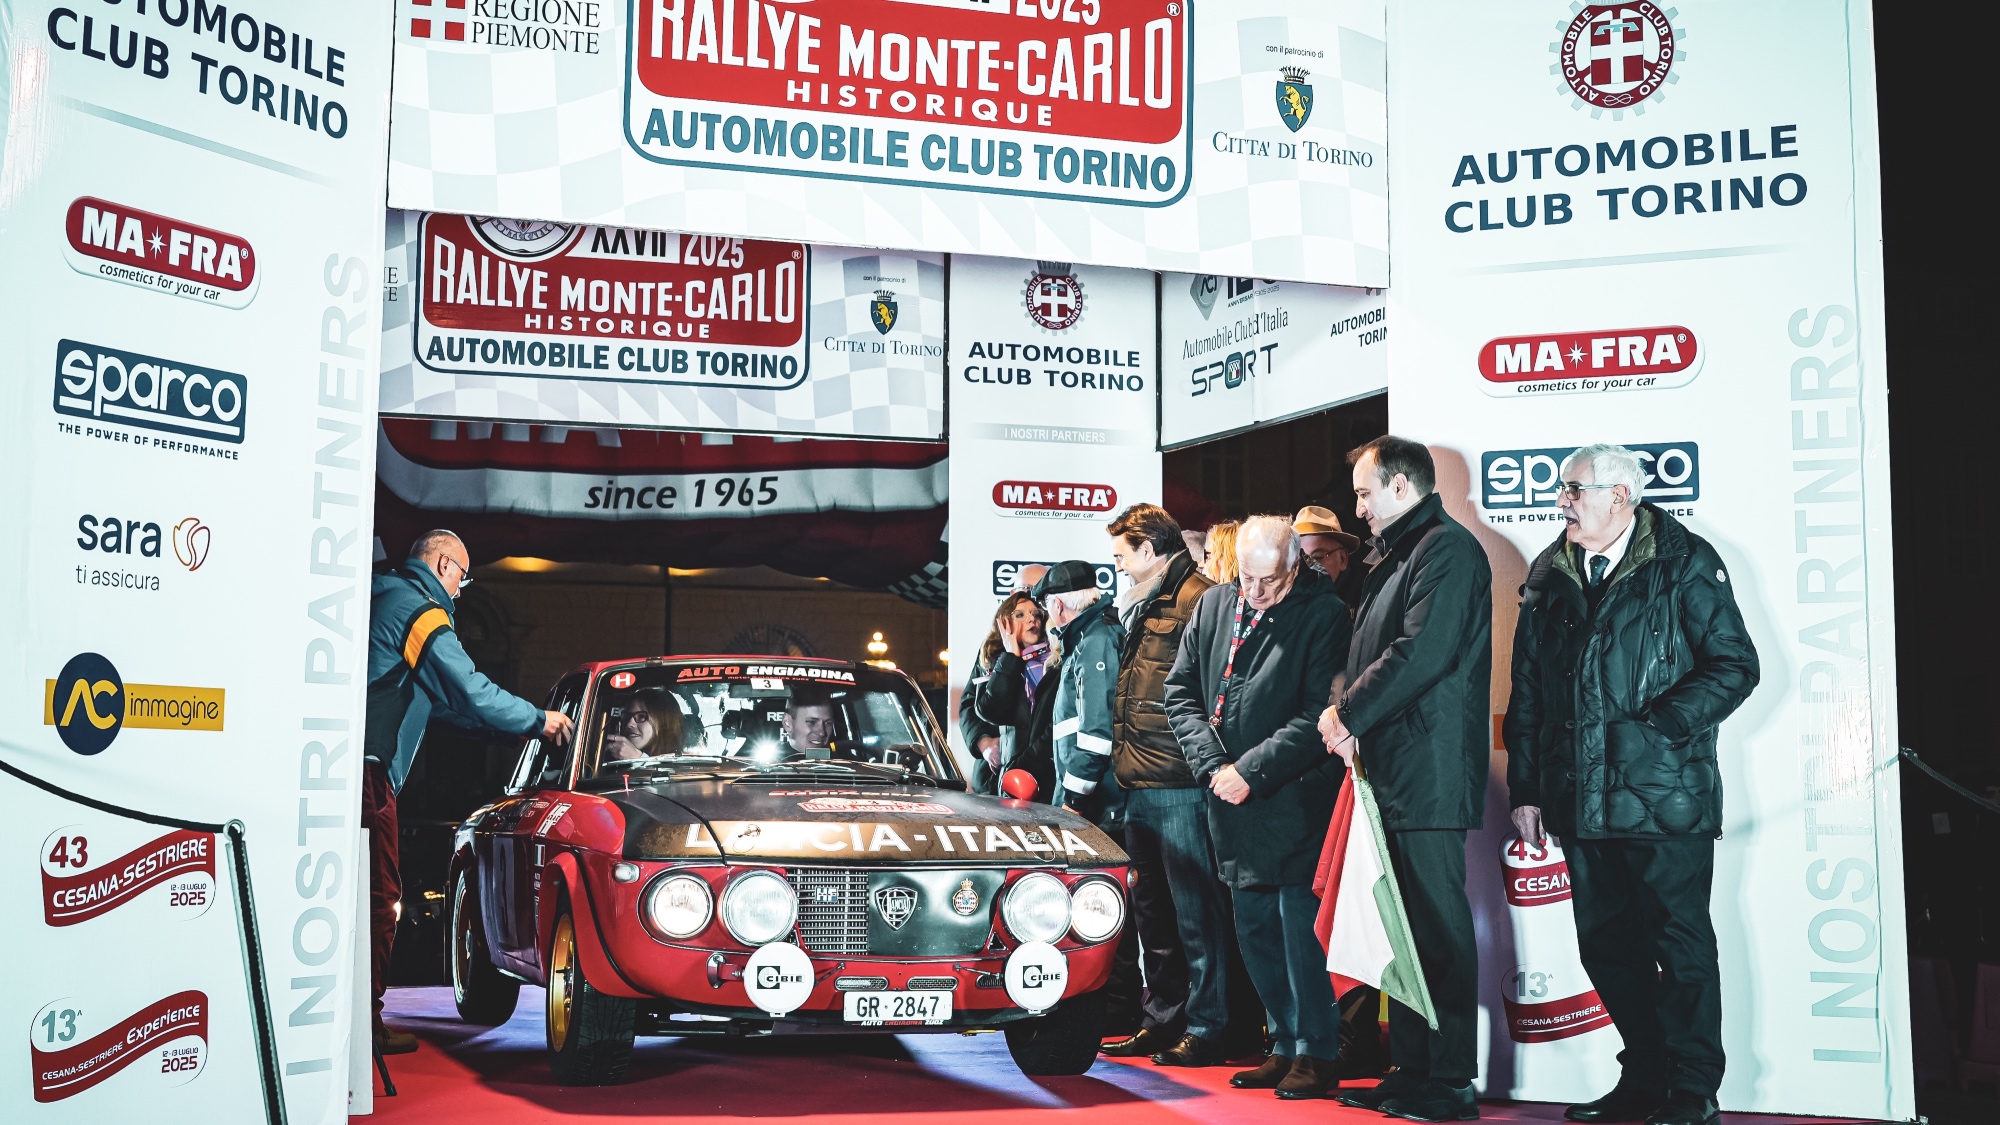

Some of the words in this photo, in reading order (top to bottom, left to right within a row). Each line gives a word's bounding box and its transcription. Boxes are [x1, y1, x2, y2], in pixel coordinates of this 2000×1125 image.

[473, 0, 600, 28] REGIONE
[1639, 3, 1669, 36] CLUB
[103, 0, 345, 87] OMOBILE
[471, 21, 600, 54] PIEMONTE
[651, 0, 821, 74] RALLYE
[839, 17, 1172, 109] MONTE-CARLO
[1284, 46, 1316, 57] patrocinio
[1318, 50, 1324, 59] di
[1563, 9, 1599, 101] AUTOMOBILE
[1639, 37, 1672, 96] TORINO
[47, 8, 169, 79] CLUB
[191, 53, 348, 139] TORINO
[787, 80, 1052, 127] HISTORIQUE
[642, 108, 909, 168] AUTOMOBILE
[921, 134, 1022, 178] CLUB
[1034, 144, 1176, 192] TORINO
[1212, 131, 1270, 157] CITTA'
[1278, 142, 1297, 160] DI
[1303, 140, 1373, 168] TORINO
[1452, 124, 1799, 187] AUTOMOBILE
[1445, 193, 1573, 233] CLUB
[1597, 172, 1808, 220] TORINO
[683, 234, 745, 269] 2025
[99, 262, 154, 286] cosmetics
[156, 274, 174, 290] for
[175, 280, 201, 297] your
[203, 288, 221, 301] car
[432, 235, 548, 310] RALLYE
[561, 260, 796, 324] MONTE-CARLO
[524, 313, 710, 339] HISTORIQUE
[1330, 306, 1385, 338] AUTOMOBI
[1358, 326, 1387, 348] TORIN
[426, 335, 610, 370] AUTOMOBILE
[617, 346, 689, 374] CLUB
[696, 351, 798, 380] TORINO
[872, 342, 886, 354] DI
[890, 340, 942, 358] TORINO
[968, 341, 1140, 368] AUTOMOBILE
[1182, 325, 1233, 361] Automobile
[61, 349, 242, 422] sparco
[964, 366, 1032, 386] CLUB
[1043, 369, 1144, 392] TORINO
[1192, 342, 1279, 397] SPORT
[1516, 379, 1578, 394] cosmetics
[1581, 377, 1600, 391] for
[1602, 379, 1633, 392] your
[1636, 376, 1657, 388] car
[58, 422, 82, 436] THE
[86, 427, 129, 443] POWER
[134, 435, 149, 446] OF
[153, 438, 239, 461] PERFORMANCE
[1010, 428, 1049, 440] NOSTRI
[1051, 430, 1106, 443] PARTNERS
[304, 252, 369, 685] PARTNERS
[584, 479, 678, 510] since
[693, 476, 779, 508] 1965
[1787, 304, 1867, 704] PARTNERS
[1014, 509, 1050, 517] cosmetics
[1051, 510, 1062, 518] for
[1064, 511, 1081, 520] your
[1489, 514, 1514, 524] THE
[1519, 513, 1565, 522] POWER
[76, 514, 162, 558] sara
[75, 564, 87, 584] ti
[91, 567, 160, 591] assicura
[677, 665, 741, 678] AUTO
[745, 665, 855, 682] ENGIADINA
[763, 679, 772, 689] 3
[129, 692, 219, 726] immagine
[48, 836, 89, 869] 43
[53, 837, 208, 909] CESANA-SESTRIERE
[288, 717, 350, 1028] NOSTRI
[1514, 871, 1571, 892] CESAN
[170, 891, 206, 907] 2025
[766, 975, 803, 983] CIBIE
[1030, 973, 1061, 981] CIBIE
[857, 996, 880, 1018] GR
[893, 996, 940, 1018] 2847
[1516, 1004, 1602, 1027] CESANA-SESTRIERE
[42, 1041, 124, 1081] CESANA-SESTRIERE
[126, 1003, 200, 1045] Experience
[161, 1055, 198, 1073] 2025
